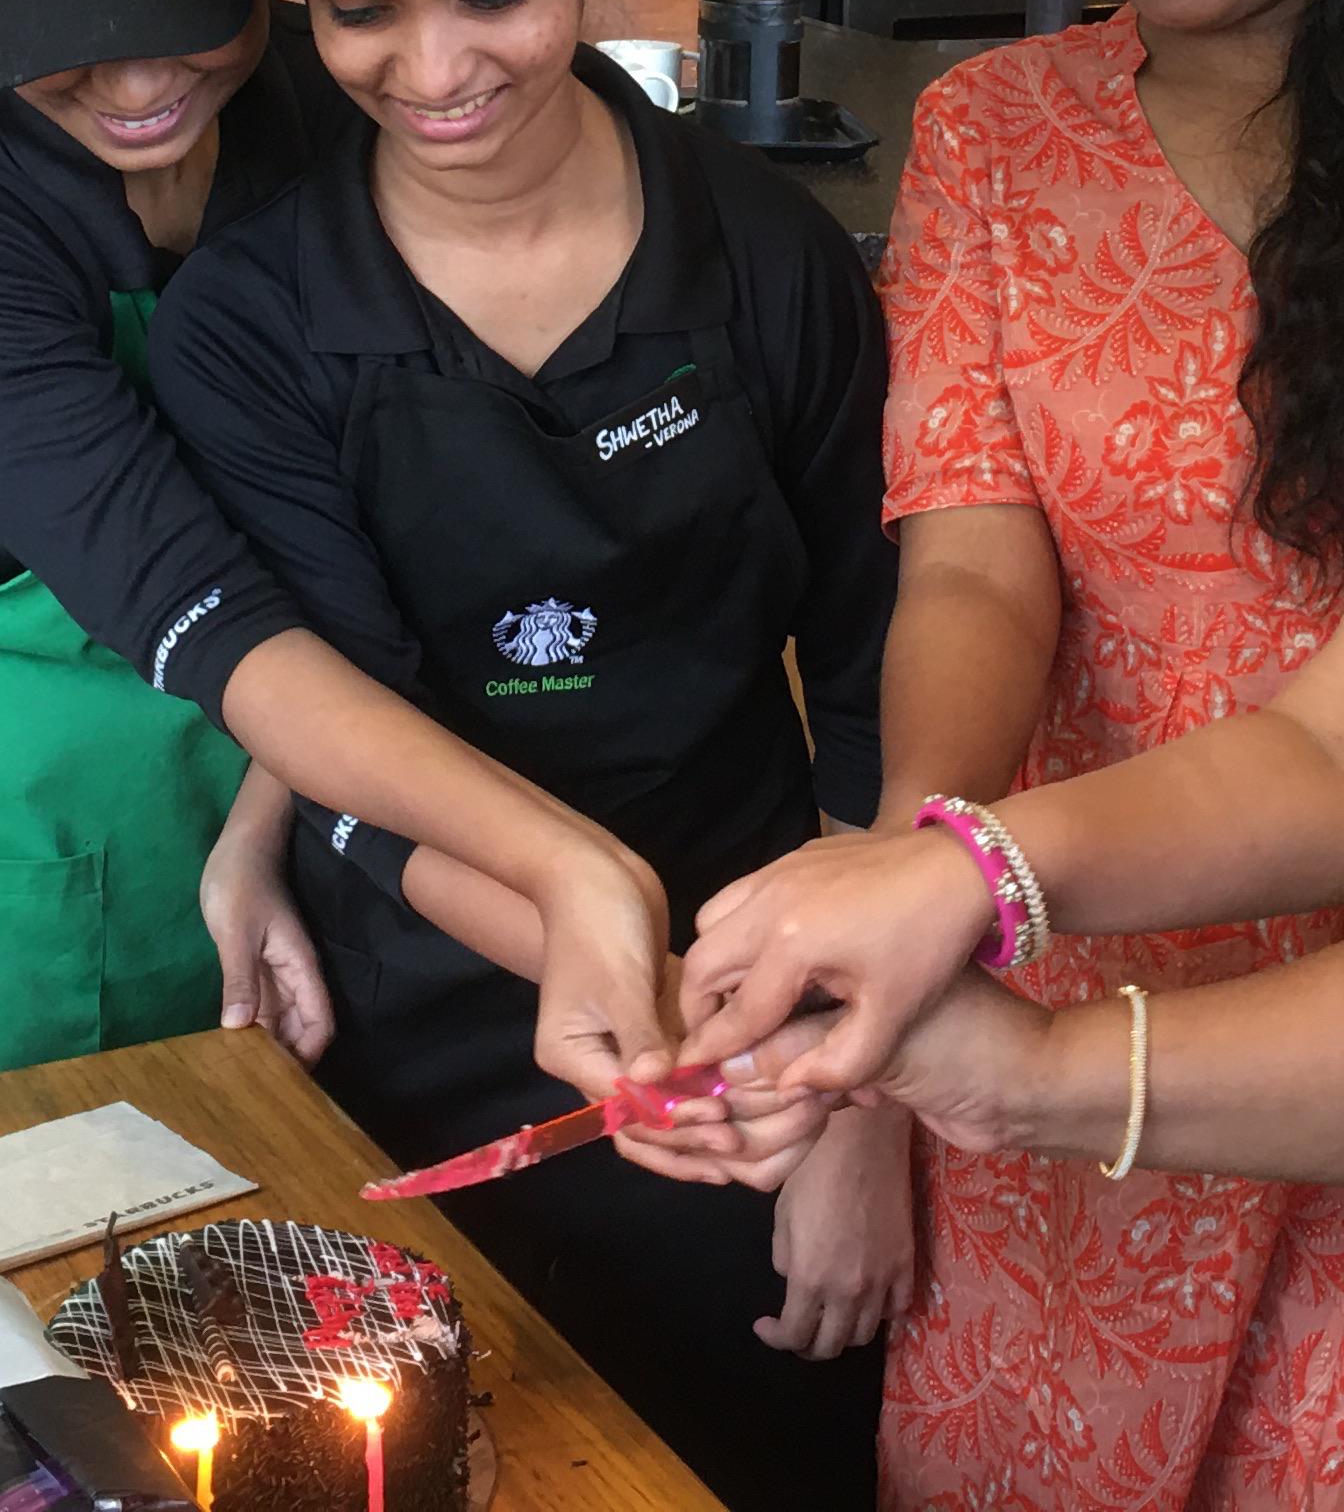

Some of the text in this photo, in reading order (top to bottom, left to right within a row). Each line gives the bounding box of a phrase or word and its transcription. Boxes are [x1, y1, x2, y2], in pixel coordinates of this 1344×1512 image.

[596, 396, 684, 461] SHWETHA
[485, 674, 596, 696] Coffee Master
